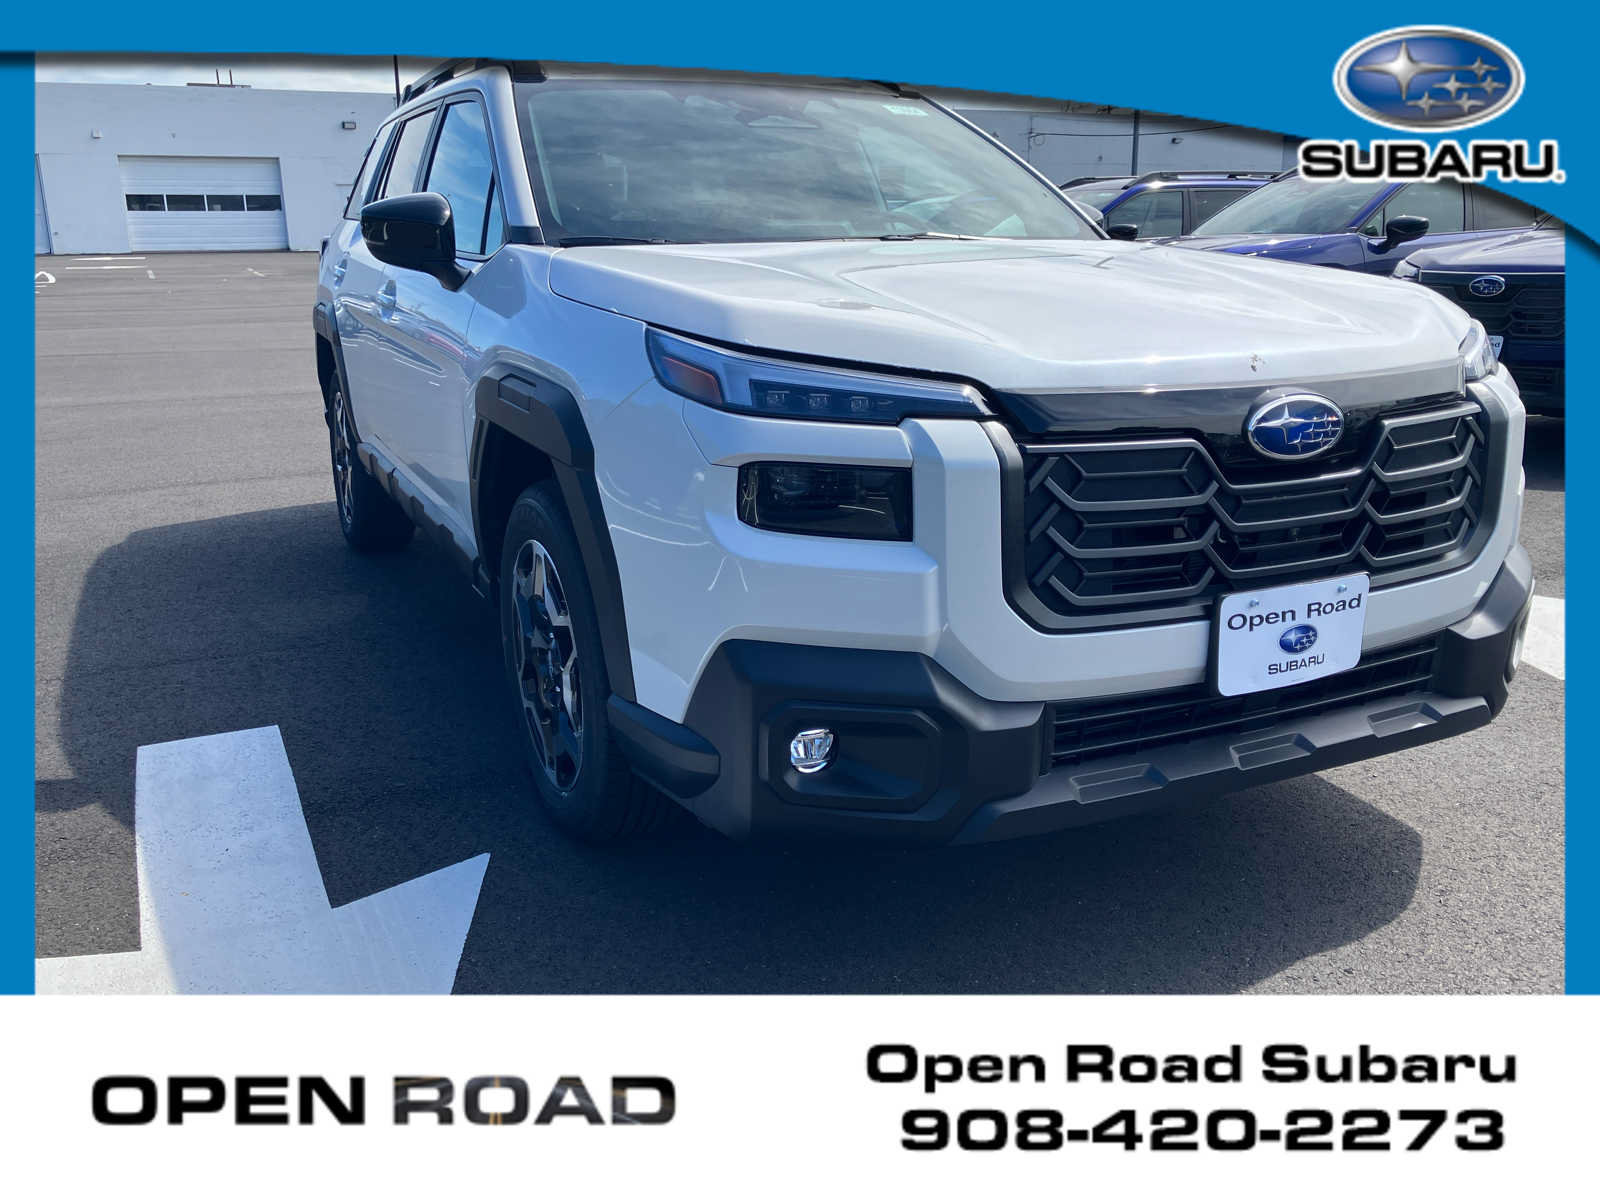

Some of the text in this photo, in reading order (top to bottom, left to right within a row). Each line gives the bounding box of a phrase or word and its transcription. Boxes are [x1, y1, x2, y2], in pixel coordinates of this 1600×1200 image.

[1227, 594, 1362, 632] Open Road
[1267, 653, 1325, 675] SUBARU
